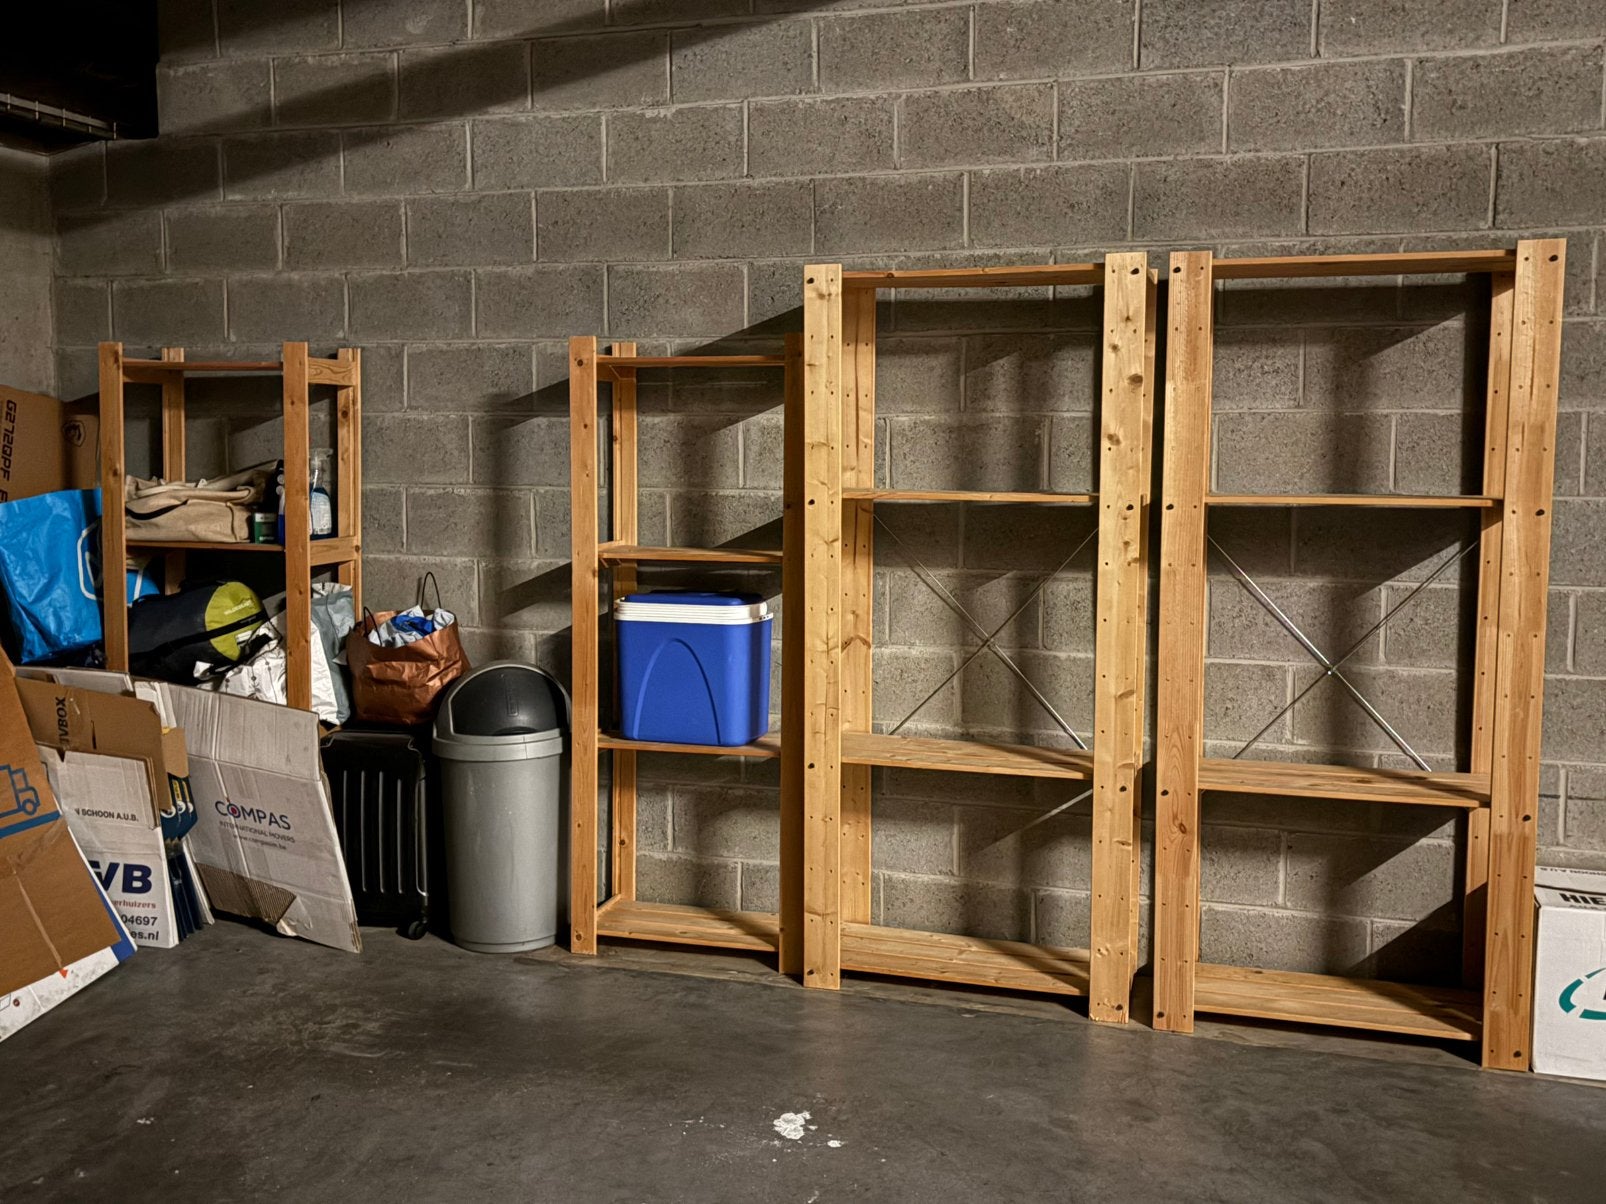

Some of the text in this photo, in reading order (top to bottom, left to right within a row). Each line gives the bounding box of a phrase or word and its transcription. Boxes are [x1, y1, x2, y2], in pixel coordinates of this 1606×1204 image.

[81, 808, 115, 819] SCHOON
[116, 812, 140, 822] A.U.B.
[215, 800, 291, 830] COMPAS
